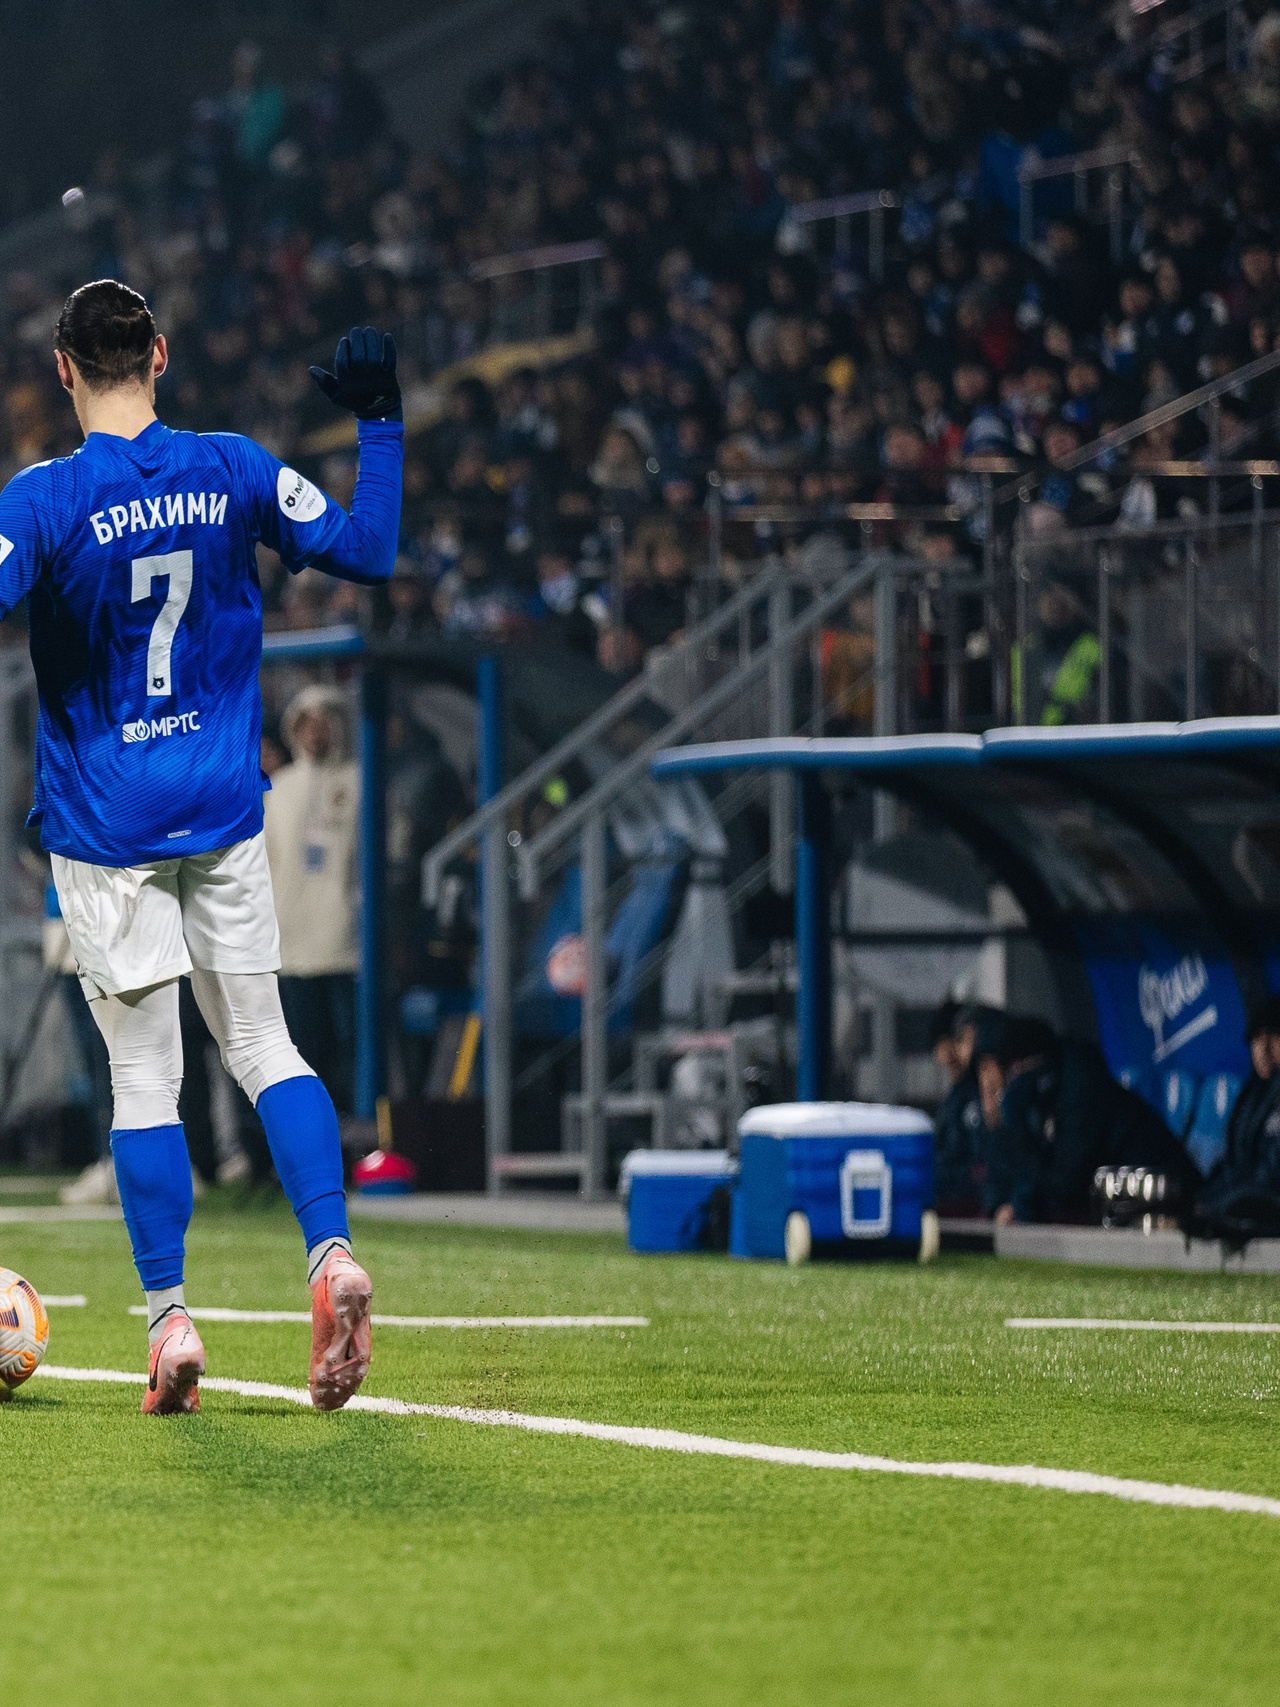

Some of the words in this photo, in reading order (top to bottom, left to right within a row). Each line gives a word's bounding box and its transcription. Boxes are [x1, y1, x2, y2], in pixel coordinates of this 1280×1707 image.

[89, 492, 228, 545] БРАХИМИ
[131, 550, 194, 696] 7
[151, 711, 201, 739] МРТС
